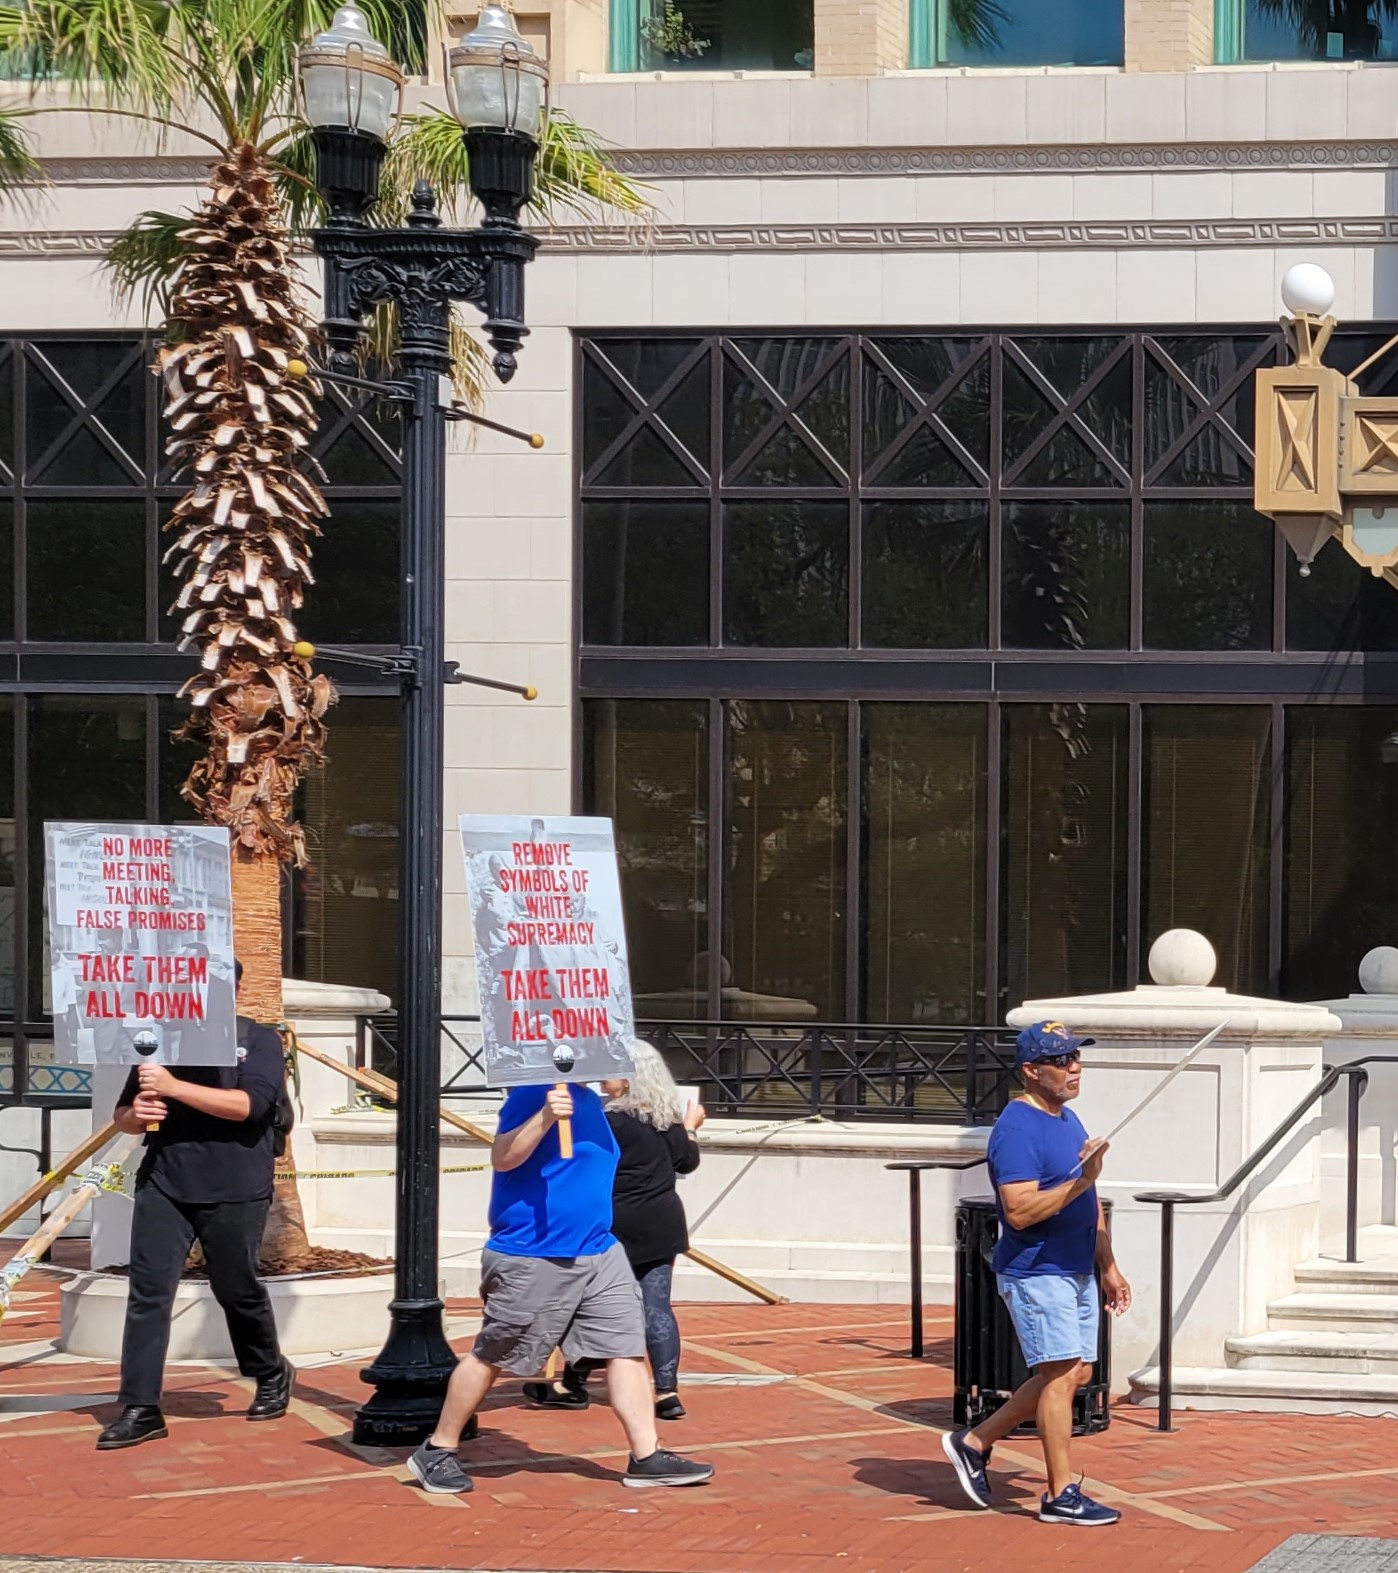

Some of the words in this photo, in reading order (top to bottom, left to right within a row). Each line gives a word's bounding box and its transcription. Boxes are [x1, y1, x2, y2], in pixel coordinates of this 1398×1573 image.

[103, 837, 124, 857] NO
[129, 838, 174, 858] MORE
[512, 842, 573, 866] REMOVE
[103, 862, 176, 884] MEETING,
[499, 869, 569, 893] SYMBOLS
[571, 869, 589, 893] OF
[105, 886, 175, 909] TALKING,
[525, 895, 573, 919] WHITE
[76, 910, 123, 930] FALSE
[128, 911, 207, 932] PROMISES
[506, 922, 594, 946] SUPREMACY
[77, 954, 137, 983] TAKE
[142, 956, 208, 984] THEM
[501, 969, 552, 1001] TAKE
[555, 968, 610, 999] THEM
[85, 990, 127, 1018] ALL
[134, 991, 205, 1021] DOWN
[511, 1009, 548, 1042] ALL
[552, 1007, 610, 1040] DOWN
